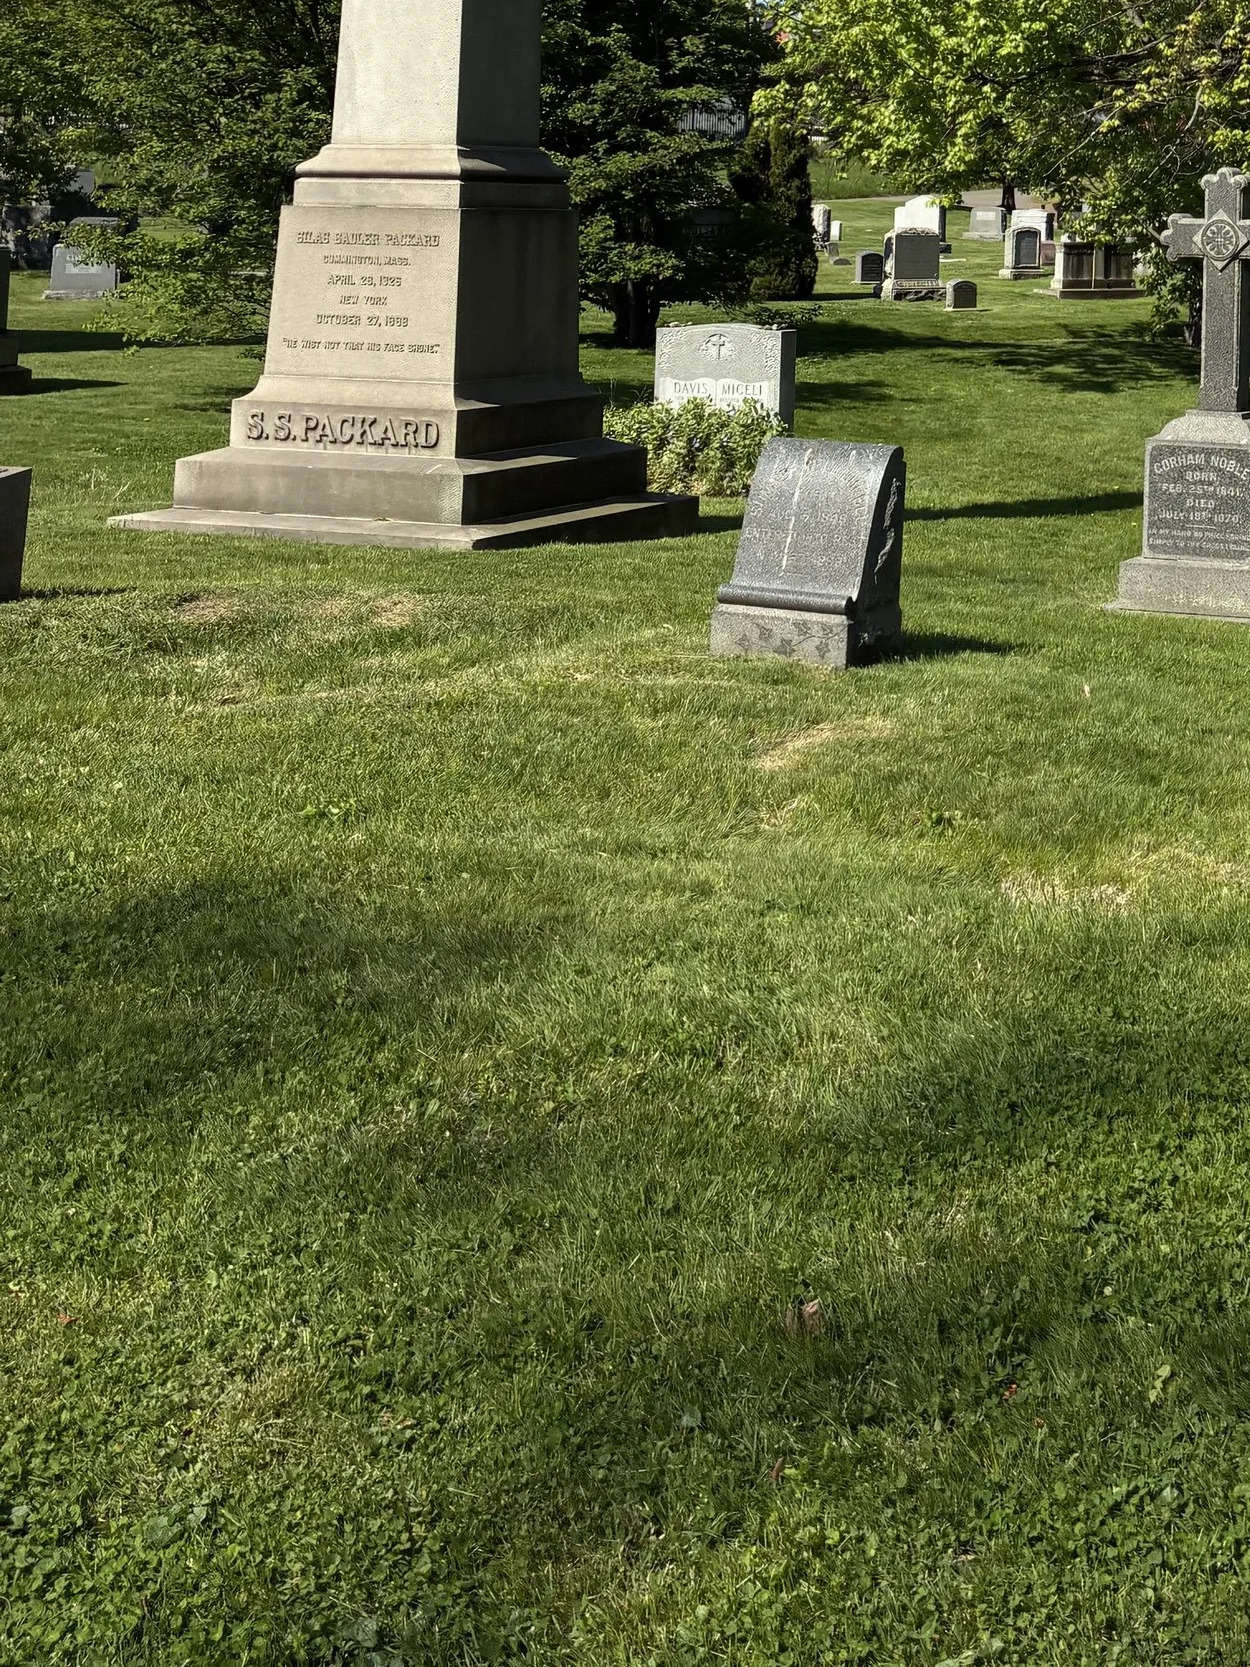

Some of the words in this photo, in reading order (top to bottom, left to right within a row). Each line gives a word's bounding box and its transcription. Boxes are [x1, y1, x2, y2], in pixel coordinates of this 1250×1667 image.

[296, 231, 330, 244] SILAS
[385, 234, 440, 247] PACKARD
[328, 274, 356, 285] APRIL
[339, 294, 359, 305] NEW
[364, 296, 388, 306] YORK
[316, 314, 361, 326] OCTOBER
[324, 340, 341, 350] NOT
[343, 340, 365, 351] THAT
[367, 342, 381, 352] HIS
[383, 342, 405, 353] FACE
[674, 382, 708, 394] DAVIS
[721, 384, 762, 396] MICELI
[247, 409, 269, 440] S.
[300, 412, 440, 448] PACKARD
[1154, 453, 1205, 474] GORHAM
[1210, 455, 1250, 480] NOBLE
[1185, 471, 1217, 481] BORN
[1161, 483, 1185, 493] FEB.
[1186, 498, 1215, 508] DIED
